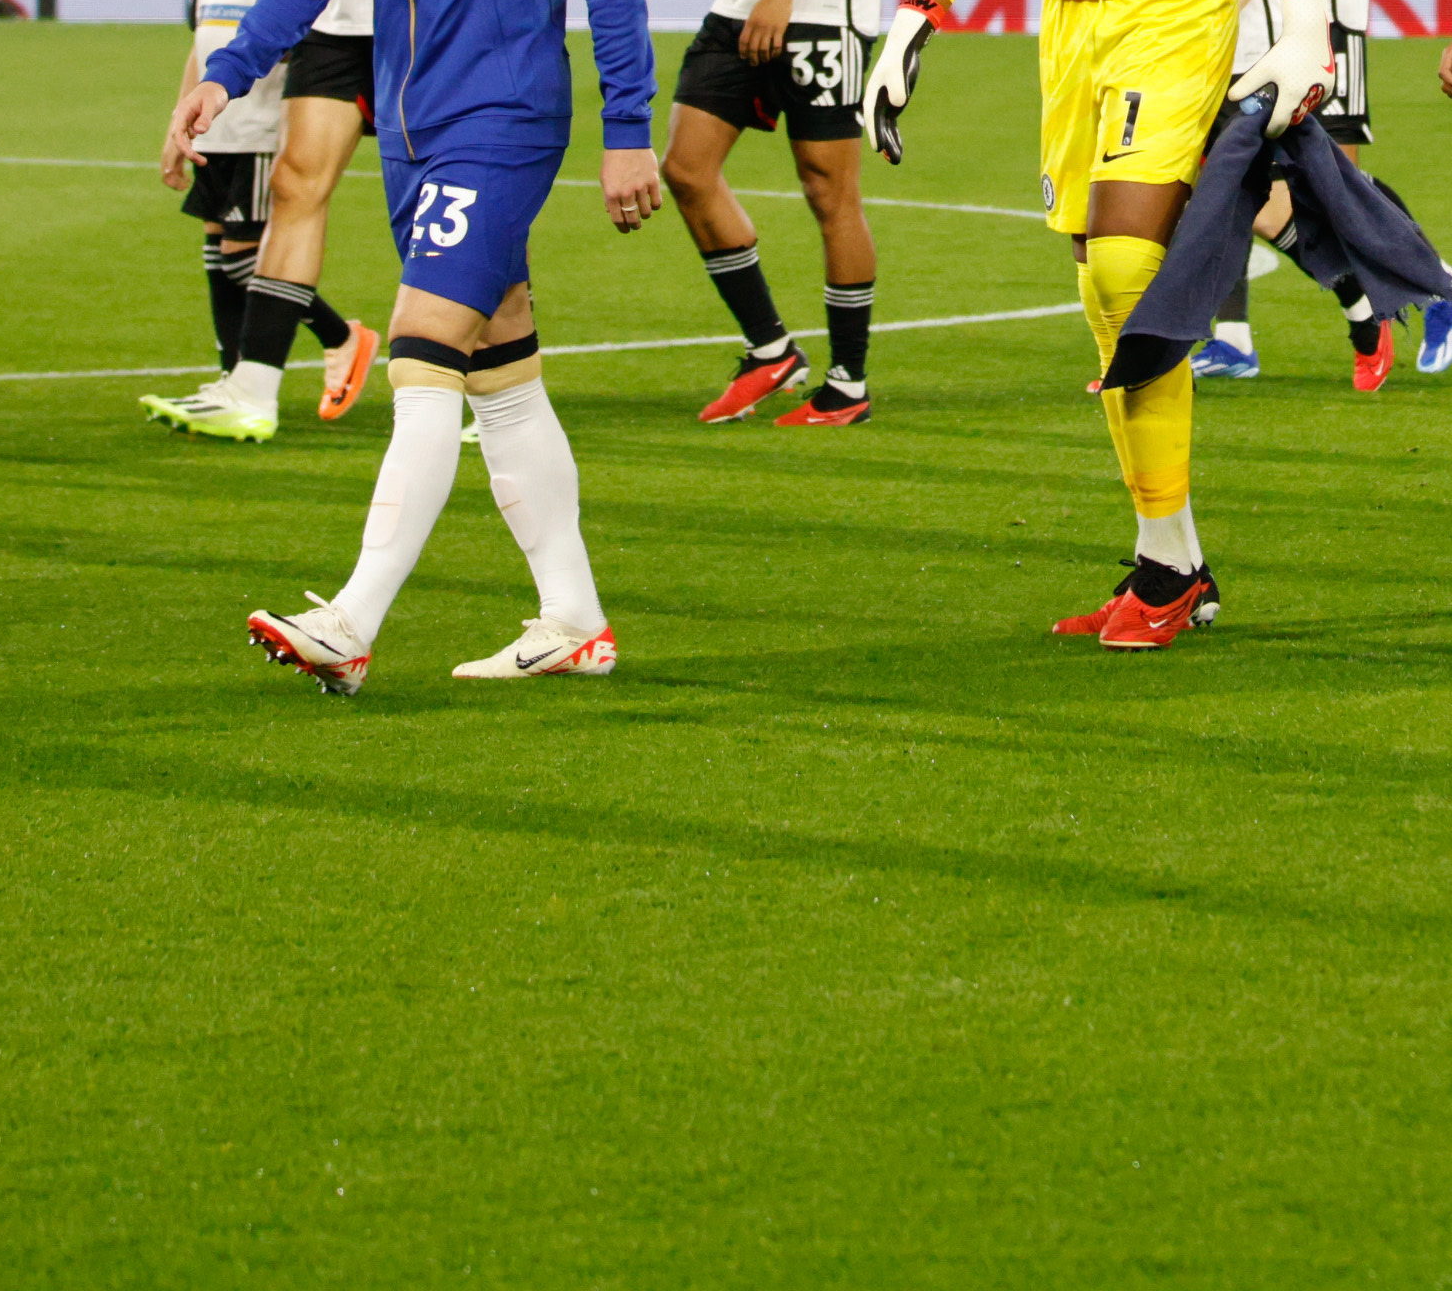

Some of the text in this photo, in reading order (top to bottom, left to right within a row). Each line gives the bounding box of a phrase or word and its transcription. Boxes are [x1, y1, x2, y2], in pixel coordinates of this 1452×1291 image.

[786, 39, 843, 89] 33
[1121, 91, 1142, 147] 1
[410, 182, 478, 248] 23
